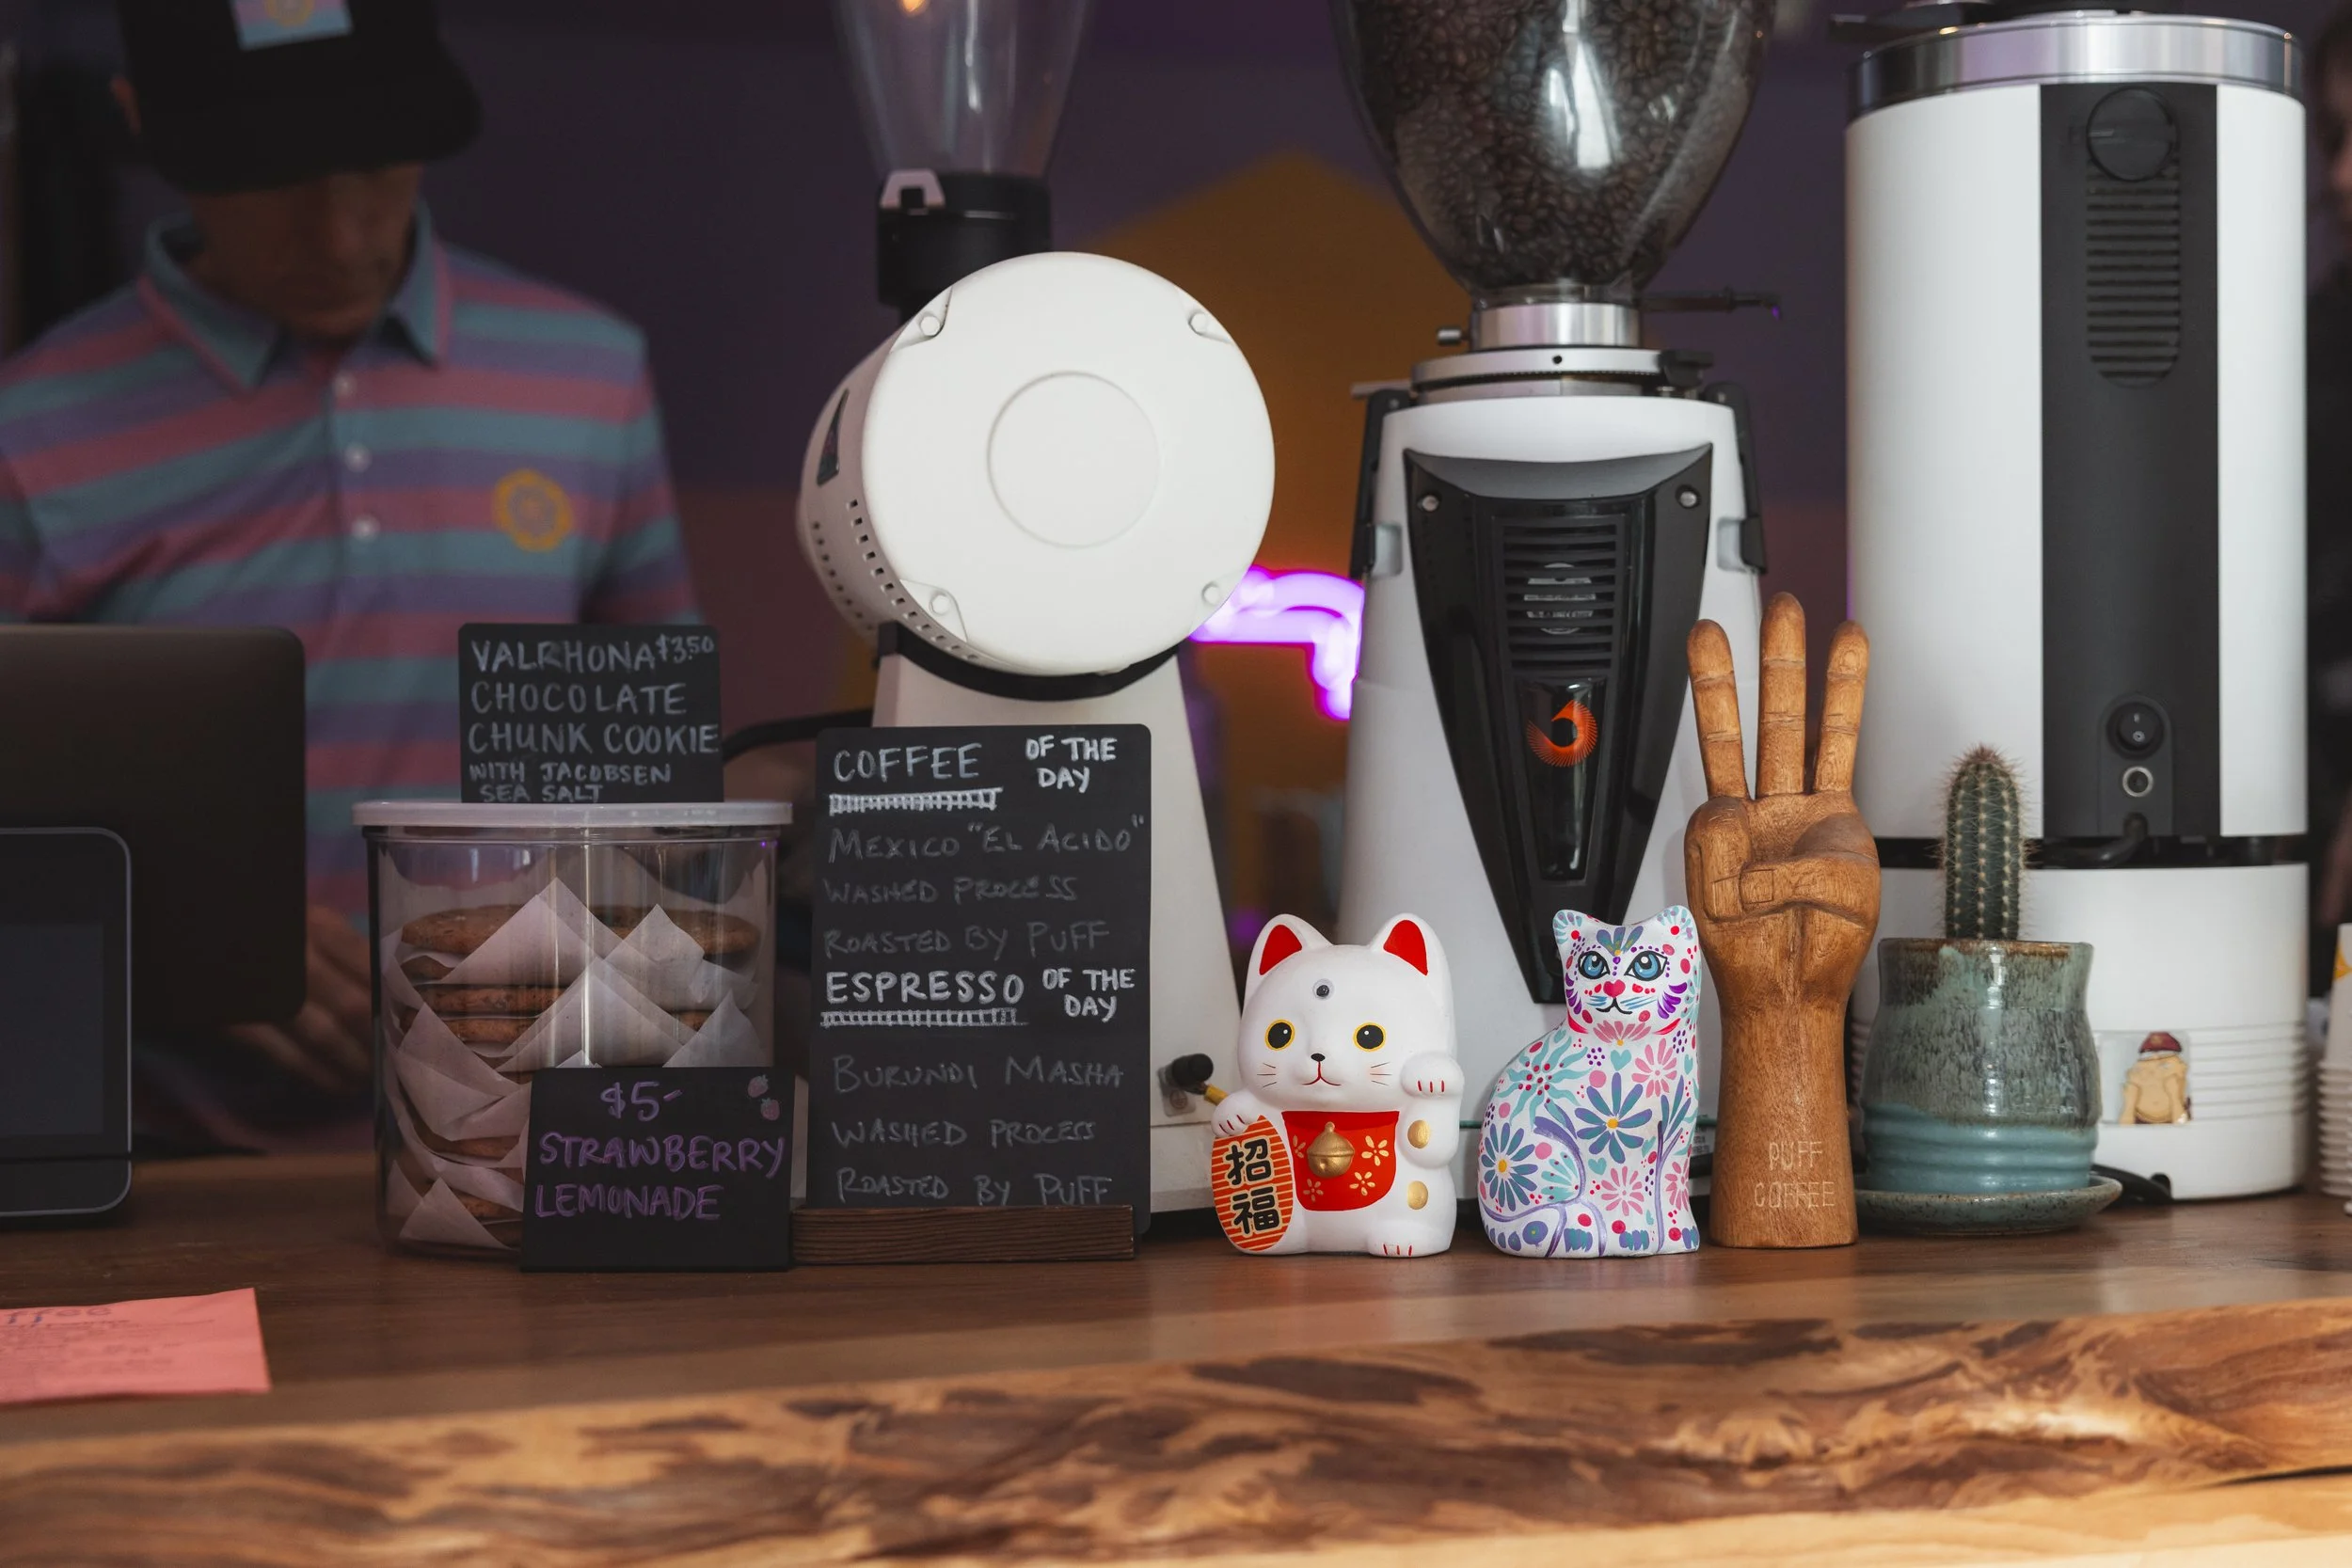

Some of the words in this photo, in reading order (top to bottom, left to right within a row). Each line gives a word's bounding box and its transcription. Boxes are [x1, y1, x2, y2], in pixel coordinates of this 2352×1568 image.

[470, 641, 656, 673] VALRHONA
[470, 681, 687, 715] CHOCOLATE
[469, 721, 593, 754] CHUNK
[603, 723, 719, 754] COOKIE
[1025, 736, 1055, 760] OF
[1061, 737, 1118, 762] THE
[469, 762, 525, 783] WITH
[539, 762, 672, 786] JACOBSEN
[834, 742, 982, 783] COFFEE
[479, 784, 531, 802] SEA
[542, 784, 604, 802] SALT
[1038, 767, 1090, 793] DAY
[964, 925, 1009, 961] BY
[1026, 921, 1110, 958] PUFF
[826, 970, 1025, 1005] ESPRESSO
[1041, 968, 1072, 990] OF
[1083, 968, 1136, 991] THE
[1063, 994, 1118, 1022] DAY
[832, 1117, 968, 1148] WASHED
[539, 1132, 786, 1179] STRAWBERRY
[1769, 1140, 1823, 1171] PUFF
[534, 1182, 724, 1221] LEMONADE
[974, 1175, 1012, 1206] BY
[1034, 1173, 1113, 1206] PUFF
[1225, 1138, 1280, 1235] 招福
[1754, 1180, 1835, 1209] COFFEE
